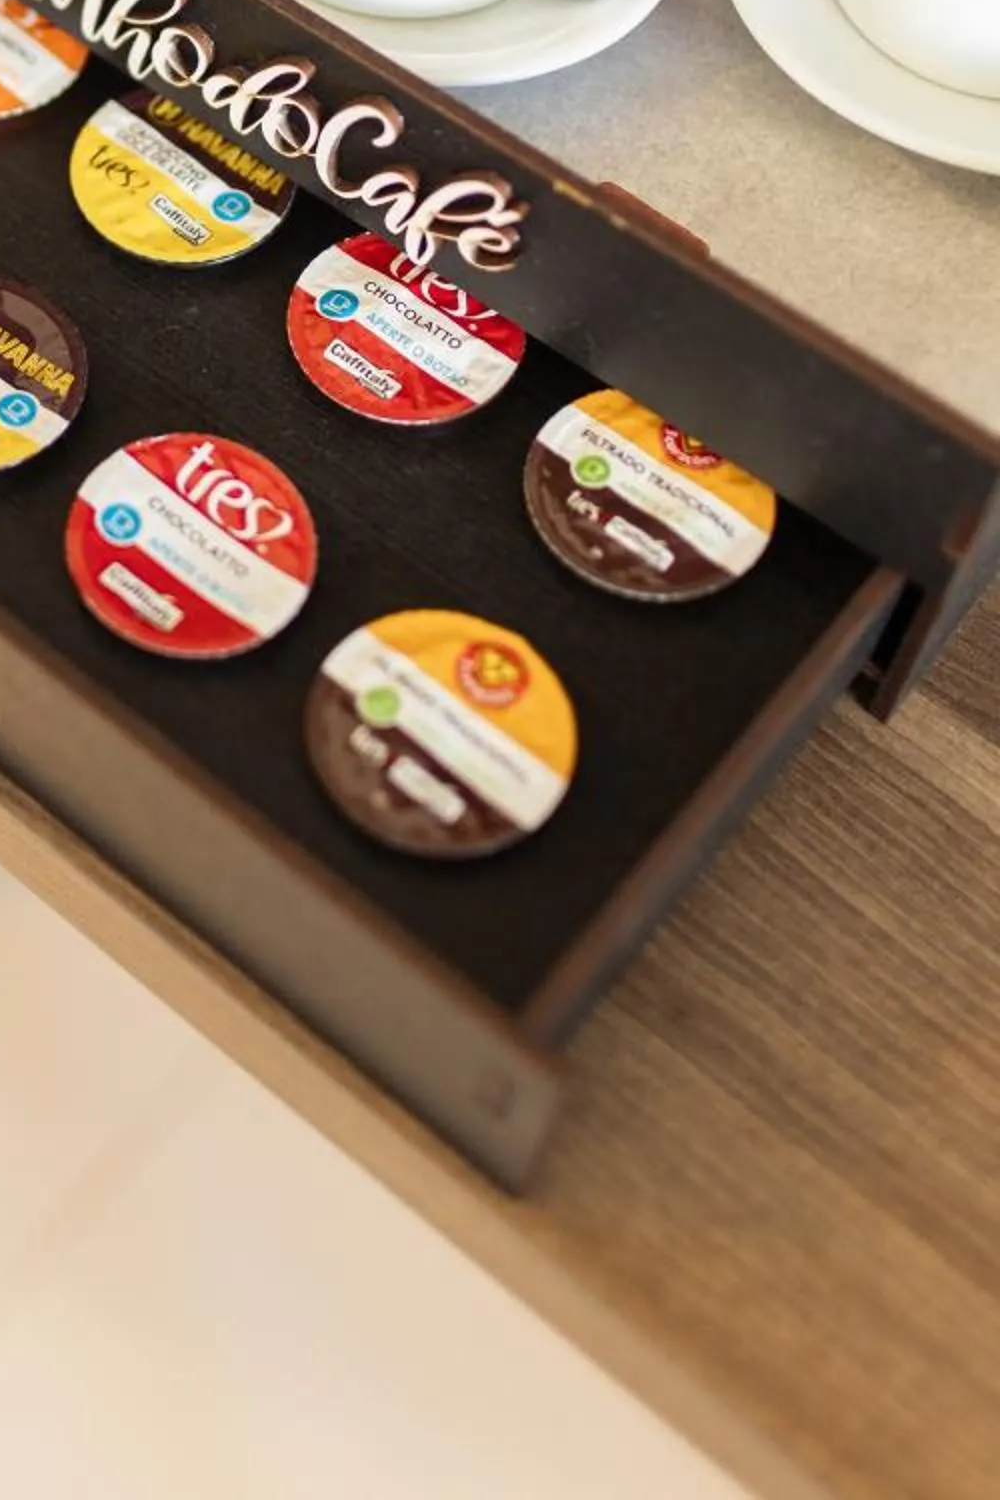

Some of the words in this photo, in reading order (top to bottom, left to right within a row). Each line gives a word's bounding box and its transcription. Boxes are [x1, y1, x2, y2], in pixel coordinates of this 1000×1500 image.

[178, 117, 288, 196] HAVANNA
[153, 197, 207, 241] Caffitaly
[363, 280, 463, 350] CHOCOLATTO
[331, 343, 394, 394] Caffitaly
[581, 427, 646, 475] FILTRADO
[648, 472, 736, 539] TRADICIONAL
[147, 495, 250, 579] CHOCOLATTO
